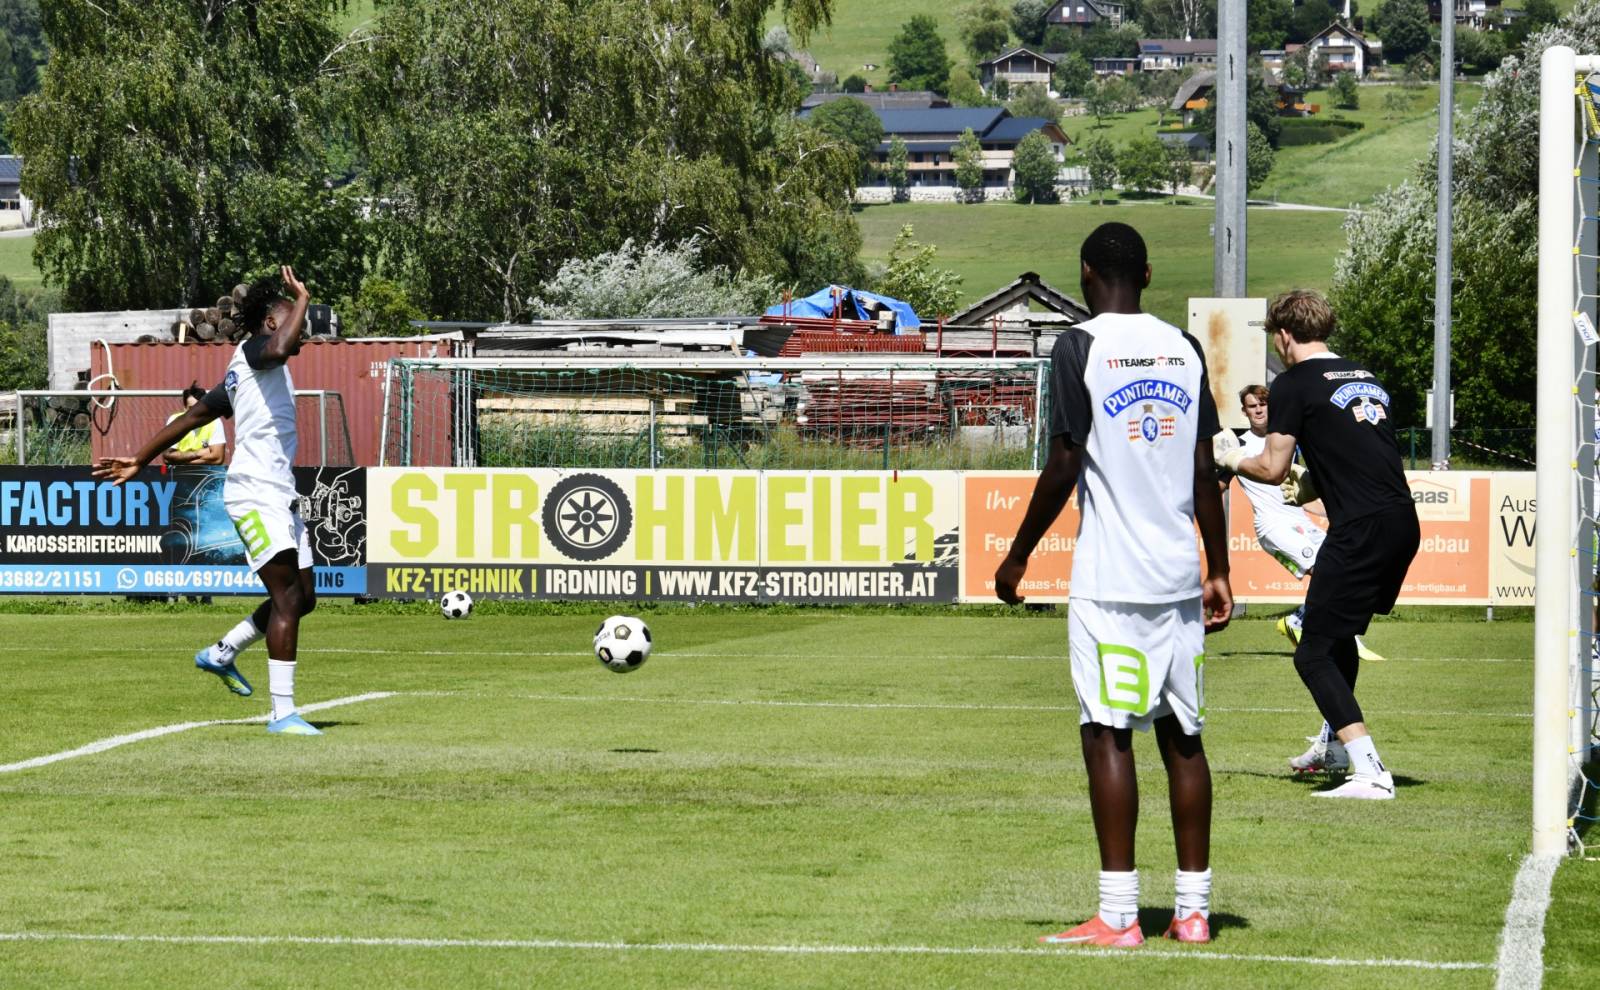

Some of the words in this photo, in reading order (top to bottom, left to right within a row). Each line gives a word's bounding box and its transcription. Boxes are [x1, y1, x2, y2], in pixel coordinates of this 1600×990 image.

[1104, 381, 1188, 415] PUNTIGAMER
[1, 481, 178, 527] FACTORY
[986, 490, 1021, 511] Ihr
[6, 535, 163, 554] KAROSSERIETECHNIK
[386, 568, 524, 594] KFZ-TECHNIK
[546, 569, 637, 595] IRDNING
[659, 571, 938, 597] WWW.KFZ-STROHMEIER.AT
